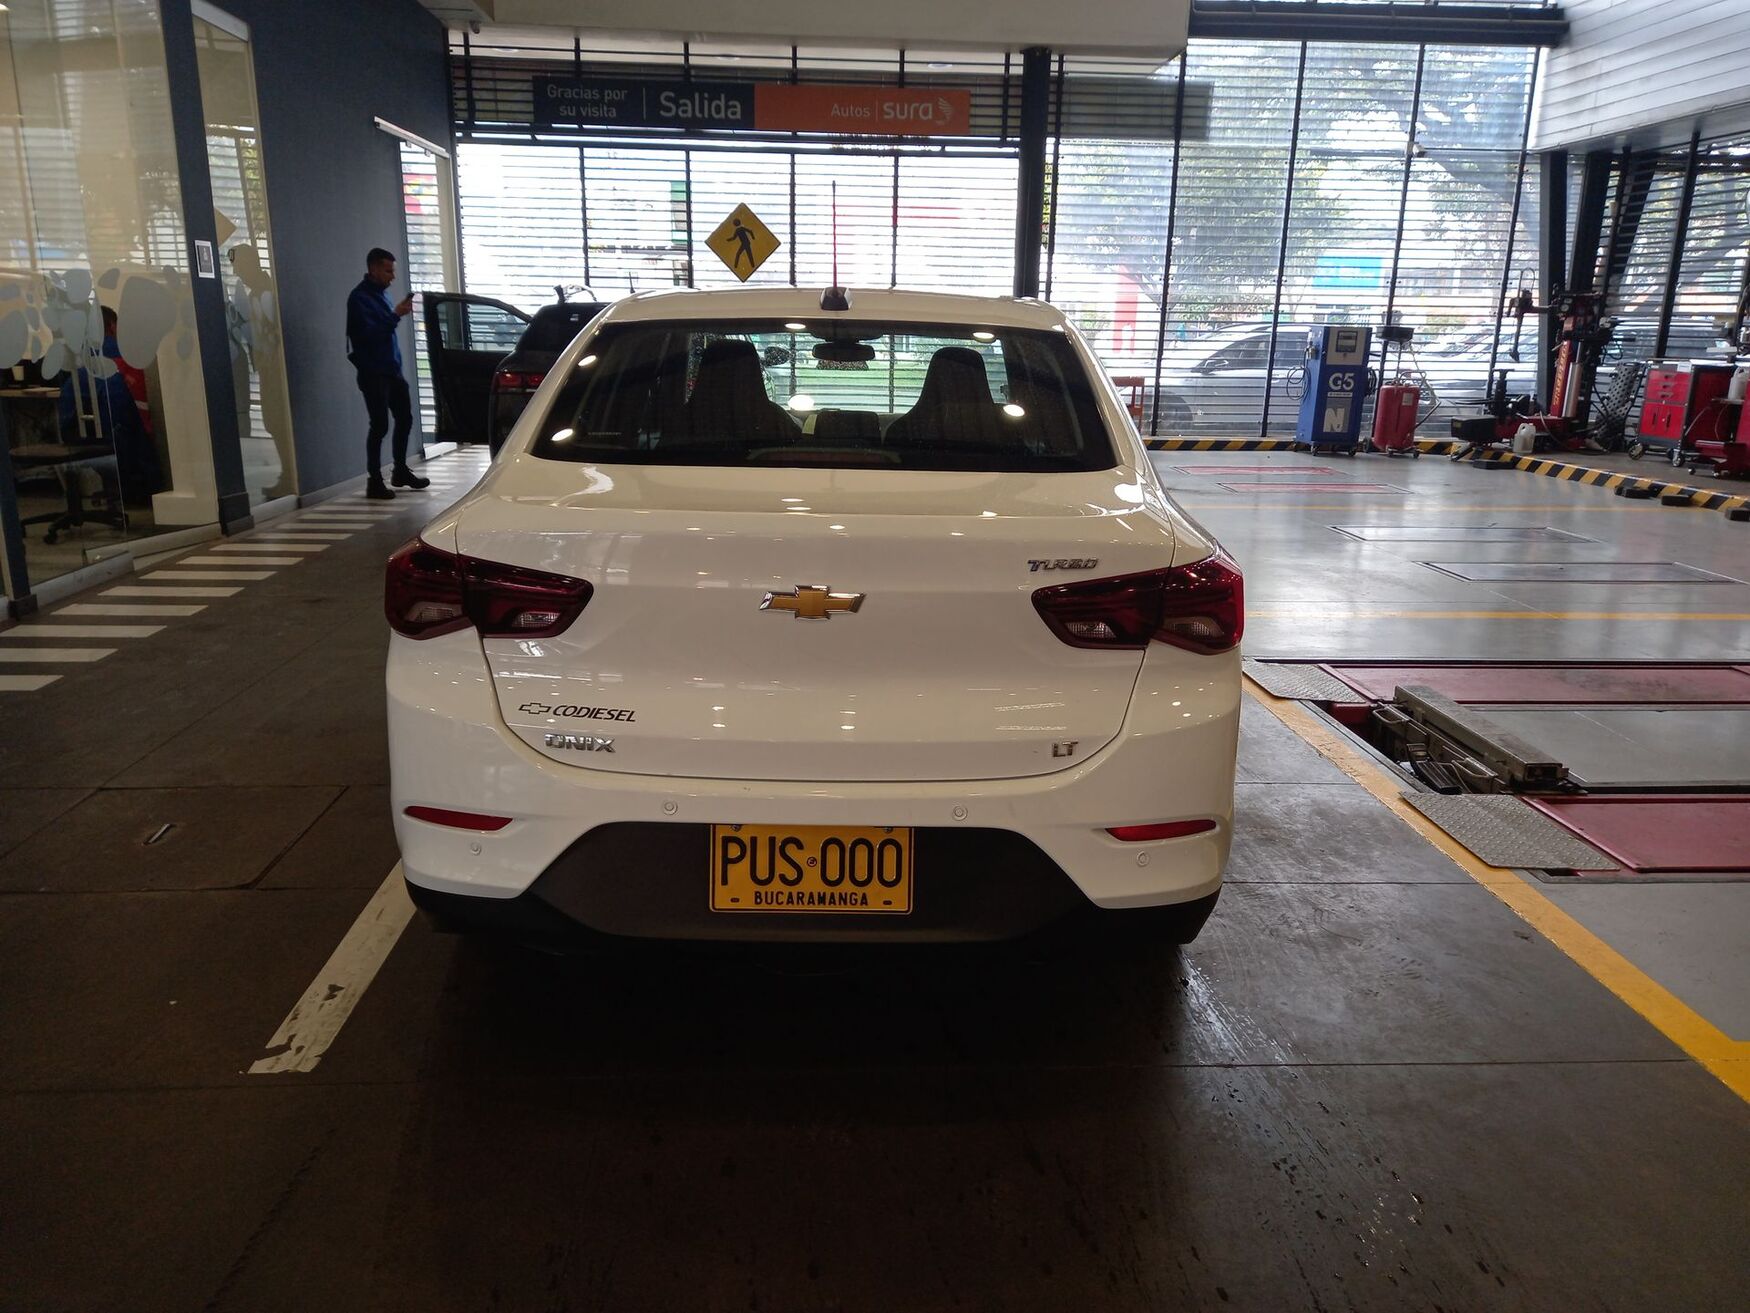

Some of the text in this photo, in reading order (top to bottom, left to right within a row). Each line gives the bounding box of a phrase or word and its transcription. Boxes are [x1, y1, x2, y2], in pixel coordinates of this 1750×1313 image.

[546, 83, 628, 103] Gracias por
[559, 102, 617, 118] su visita
[659, 90, 741, 120] Salida
[831, 103, 871, 118] Autos
[882, 102, 933, 120] sura
[1328, 372, 1355, 391] G5
[552, 704, 636, 723] CODIESEL
[544, 732, 616, 753] ONIX
[1052, 741, 1079, 758] LT
[753, 890, 869, 907] BUCARAMANGA
